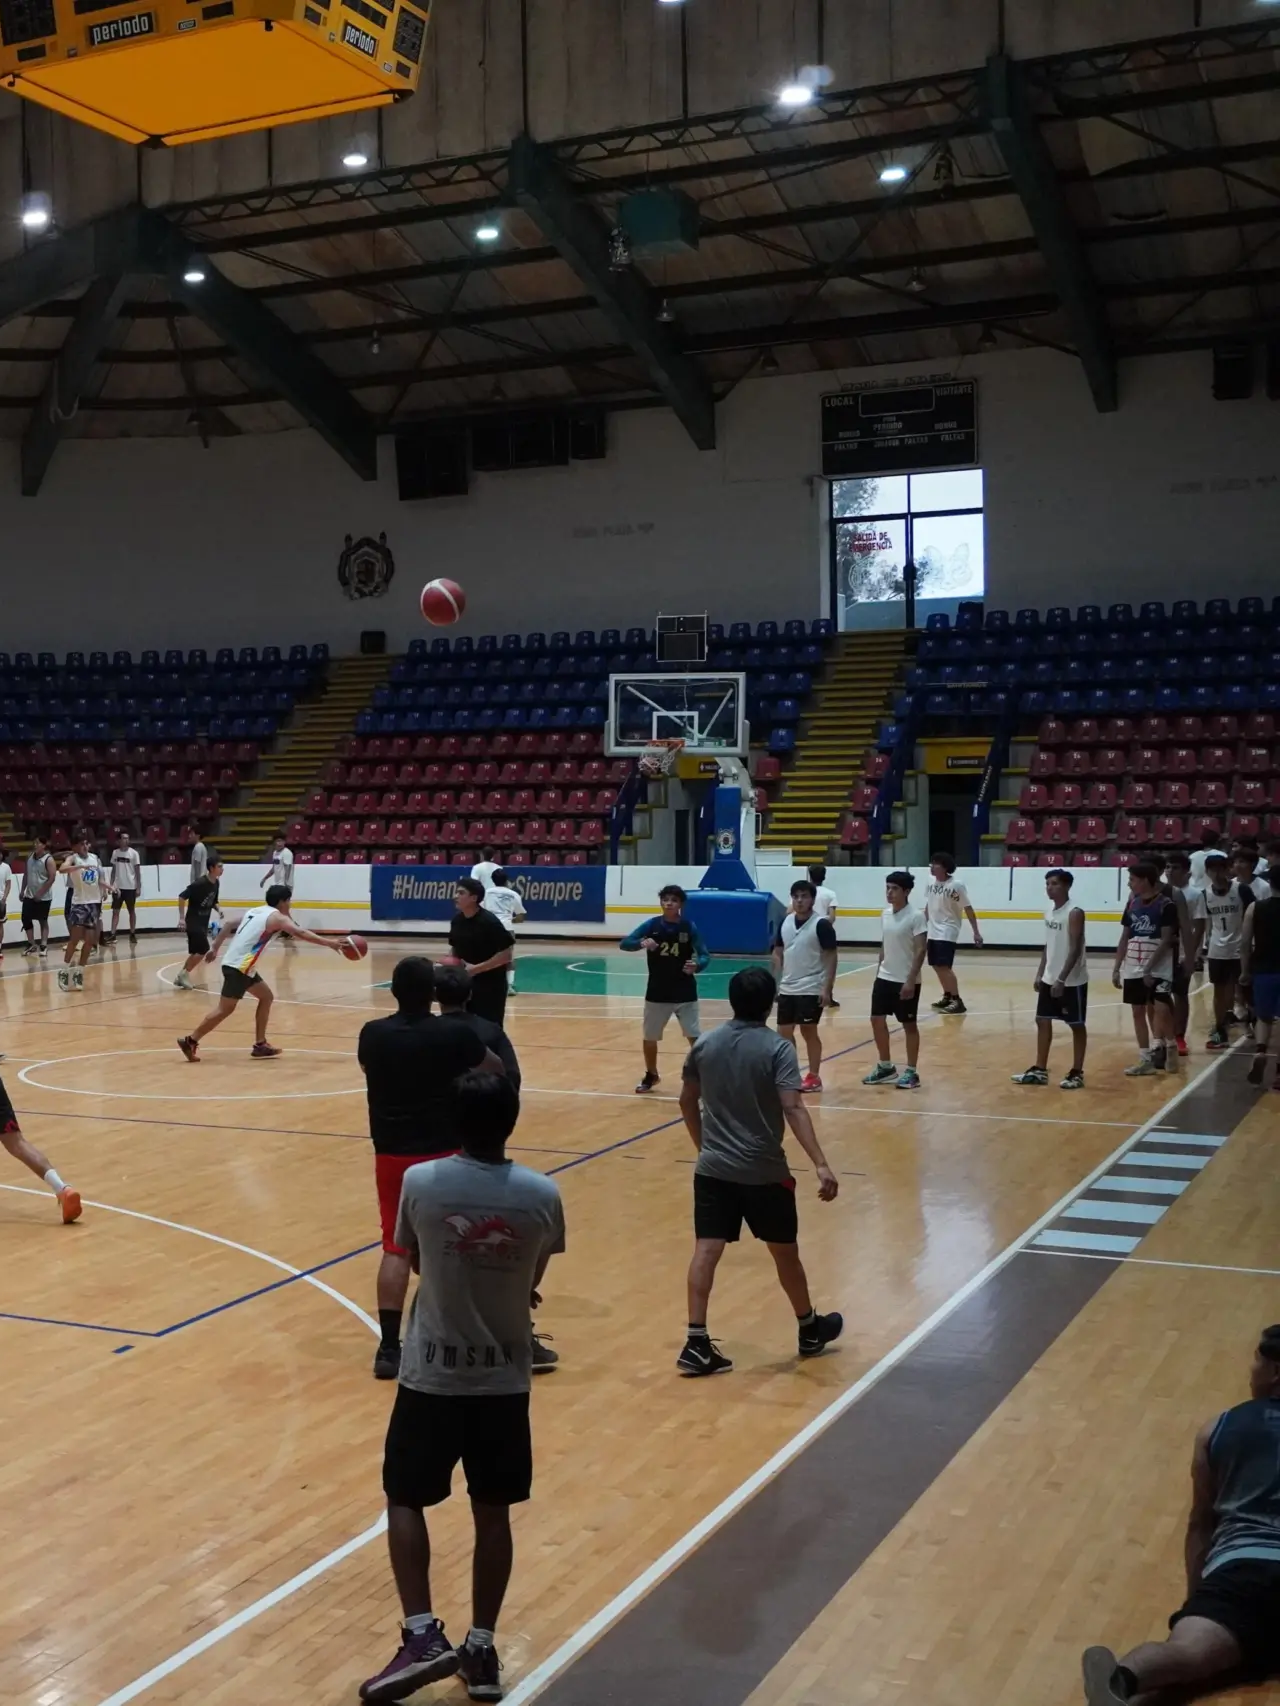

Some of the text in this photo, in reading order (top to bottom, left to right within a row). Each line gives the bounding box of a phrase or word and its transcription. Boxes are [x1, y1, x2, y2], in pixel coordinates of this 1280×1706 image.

[92, 14, 149, 46] periodo
[344, 25, 375, 54] periodo
[825, 396, 855, 408] LOCAL
[82, 871, 95, 881] M
[239, 915, 255, 934] 7
[1220, 917, 1227, 931] 1
[659, 941, 680, 957] 24
